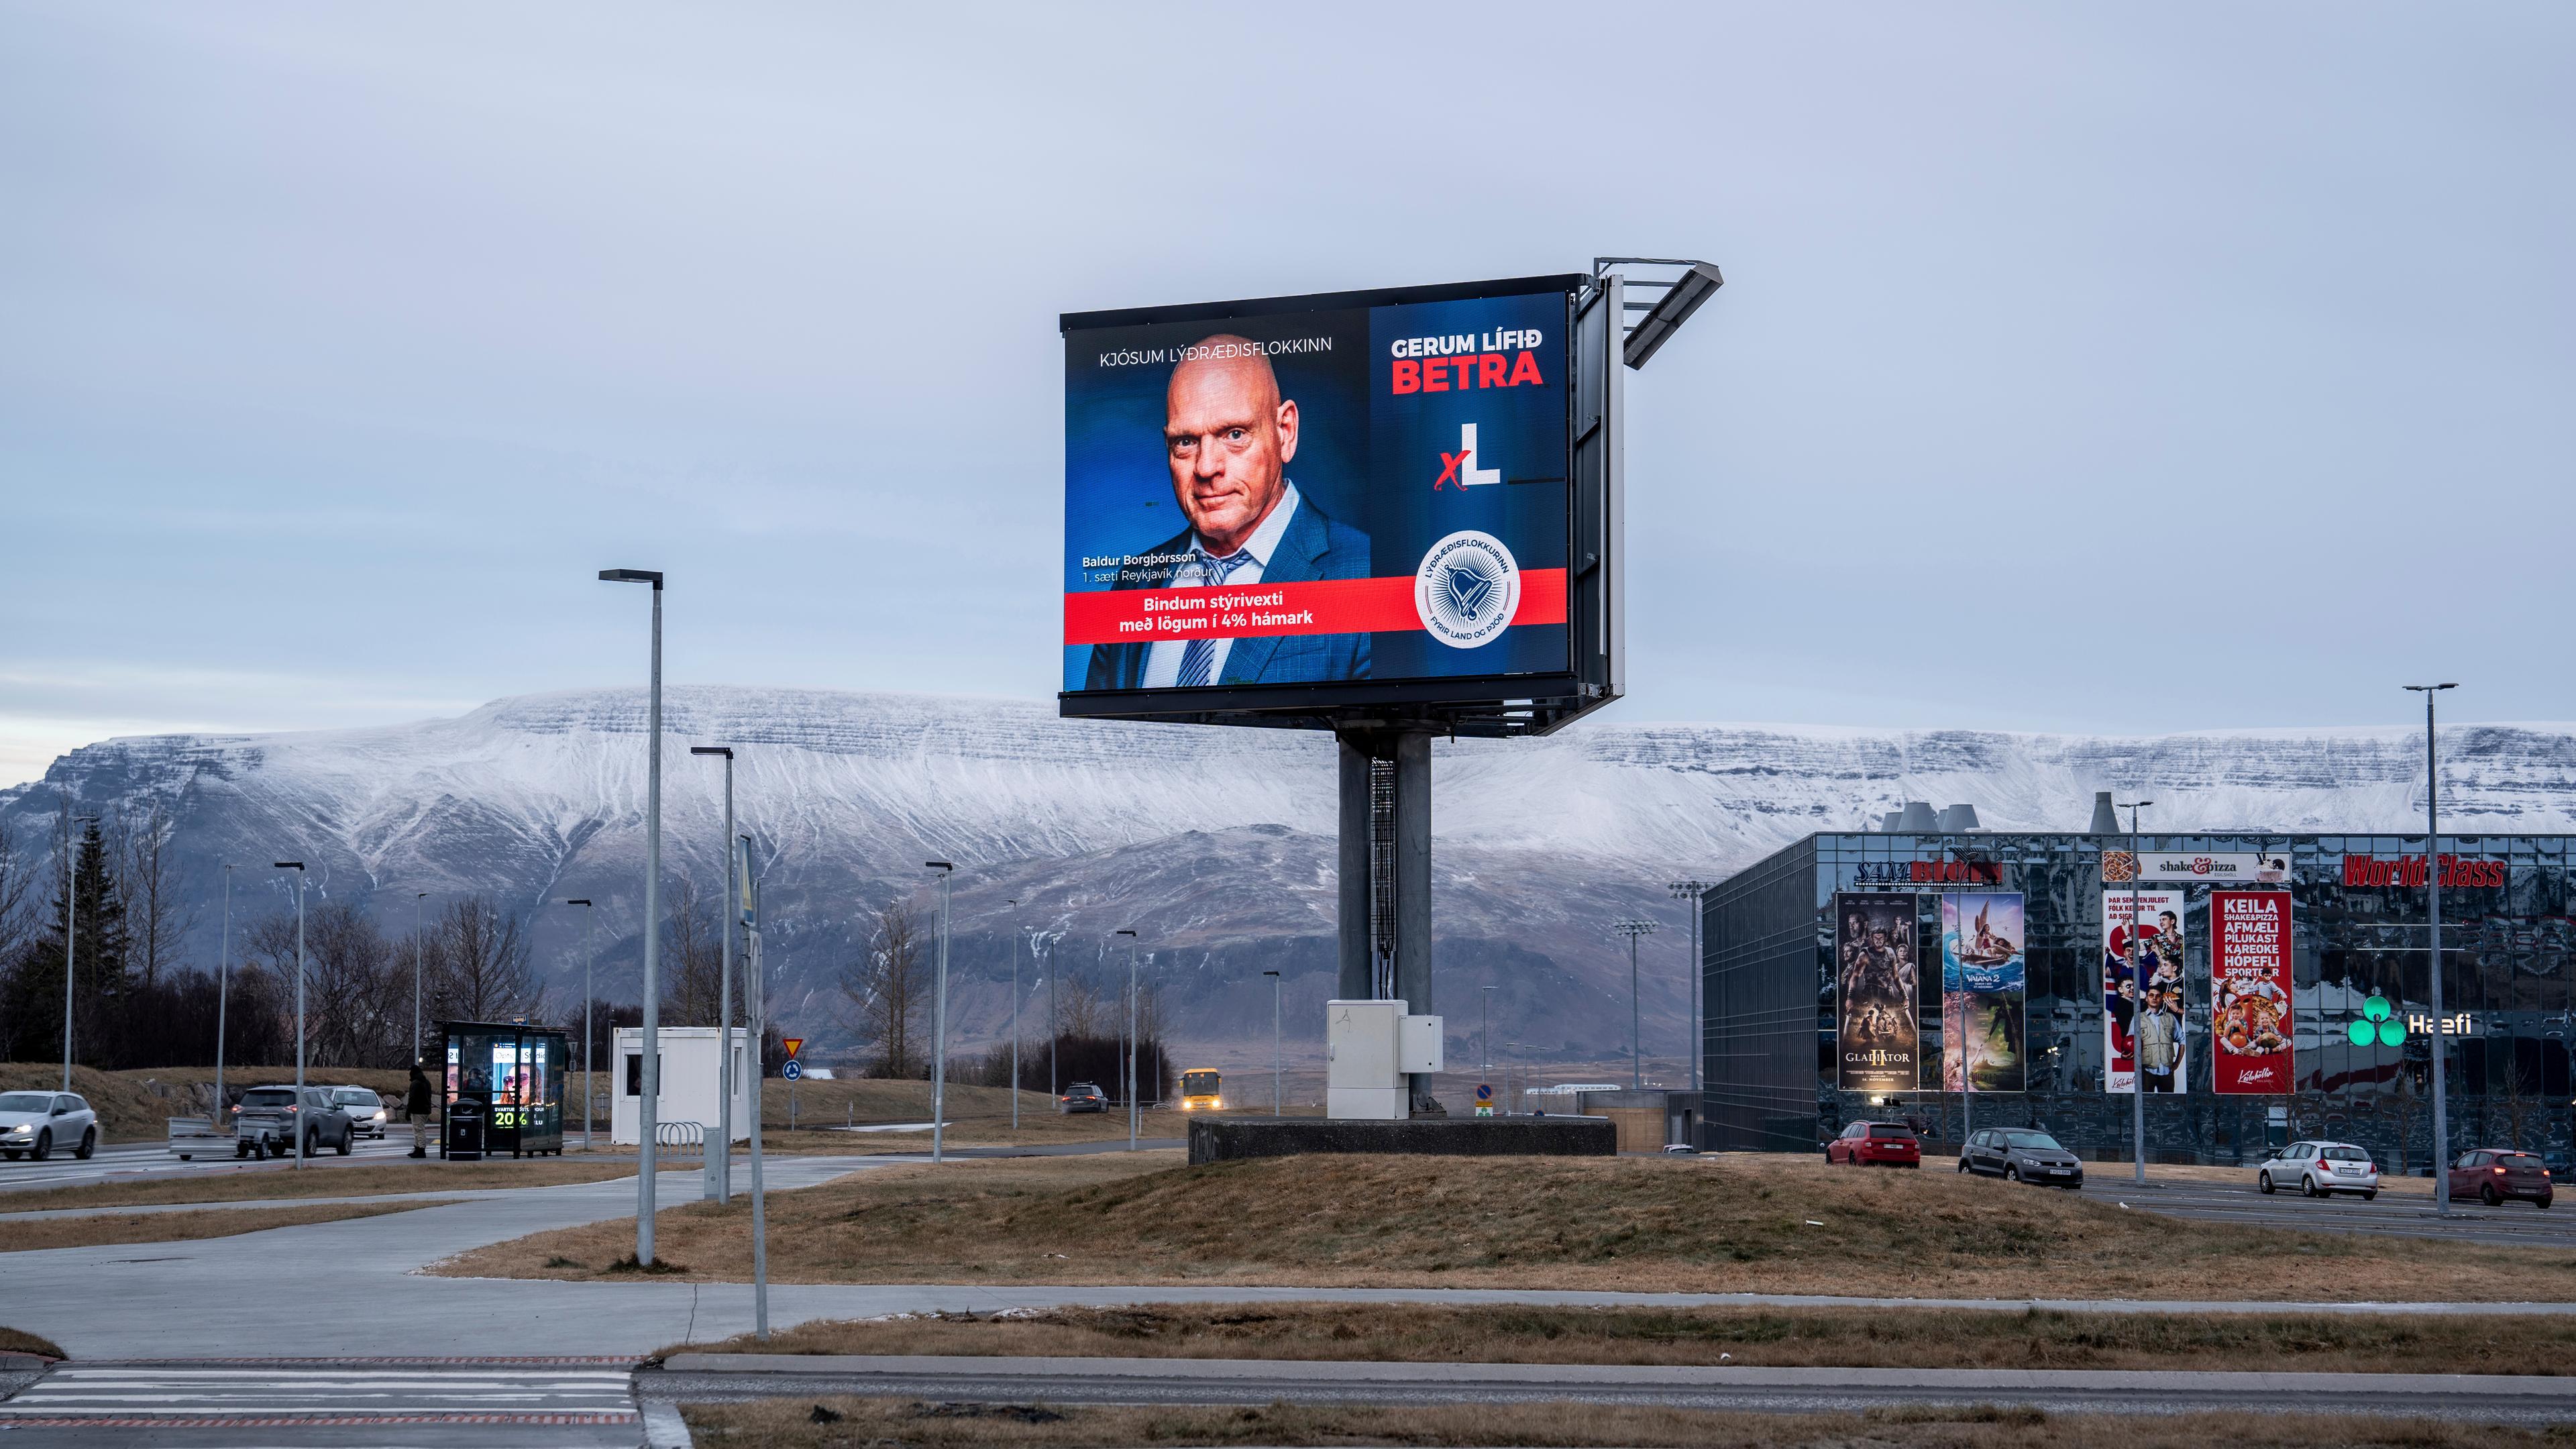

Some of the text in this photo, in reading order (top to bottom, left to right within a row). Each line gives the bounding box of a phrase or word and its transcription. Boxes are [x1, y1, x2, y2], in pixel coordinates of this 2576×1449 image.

[1391, 326, 1543, 358] GERUM LÍFIÐ
[1100, 337, 1332, 367] KJÓSUM LÝÐRÆÐISFLOKKINN
[1392, 351, 1543, 395] BETRA
[1082, 552, 1196, 569] Baldur Borgþórsson
[1425, 539, 1509, 578] LÝÐRÆÐISFLOKKURINN
[1083, 566, 1214, 583] 1. sæti Reykjavík norður
[1144, 590, 1283, 611] Bindum stýrivexti
[1120, 610, 1313, 633] með lögum í 4% hámark
[1430, 612, 1505, 640] FYRIR LAND OG ÞJÓÐ
[2344, 854, 2426, 887] World
[2224, 899, 2278, 913] KEILA
[2224, 922, 2279, 932] AFMÆLI
[2224, 932, 2278, 943] PÍLUKAST
[2224, 945, 2279, 953] KAREOKE
[2224, 953, 2279, 967] HÓPEFLI
[1966, 974, 2000, 982] VAIANA 2
[1845, 1053, 1910, 1062] GLADIATOR
